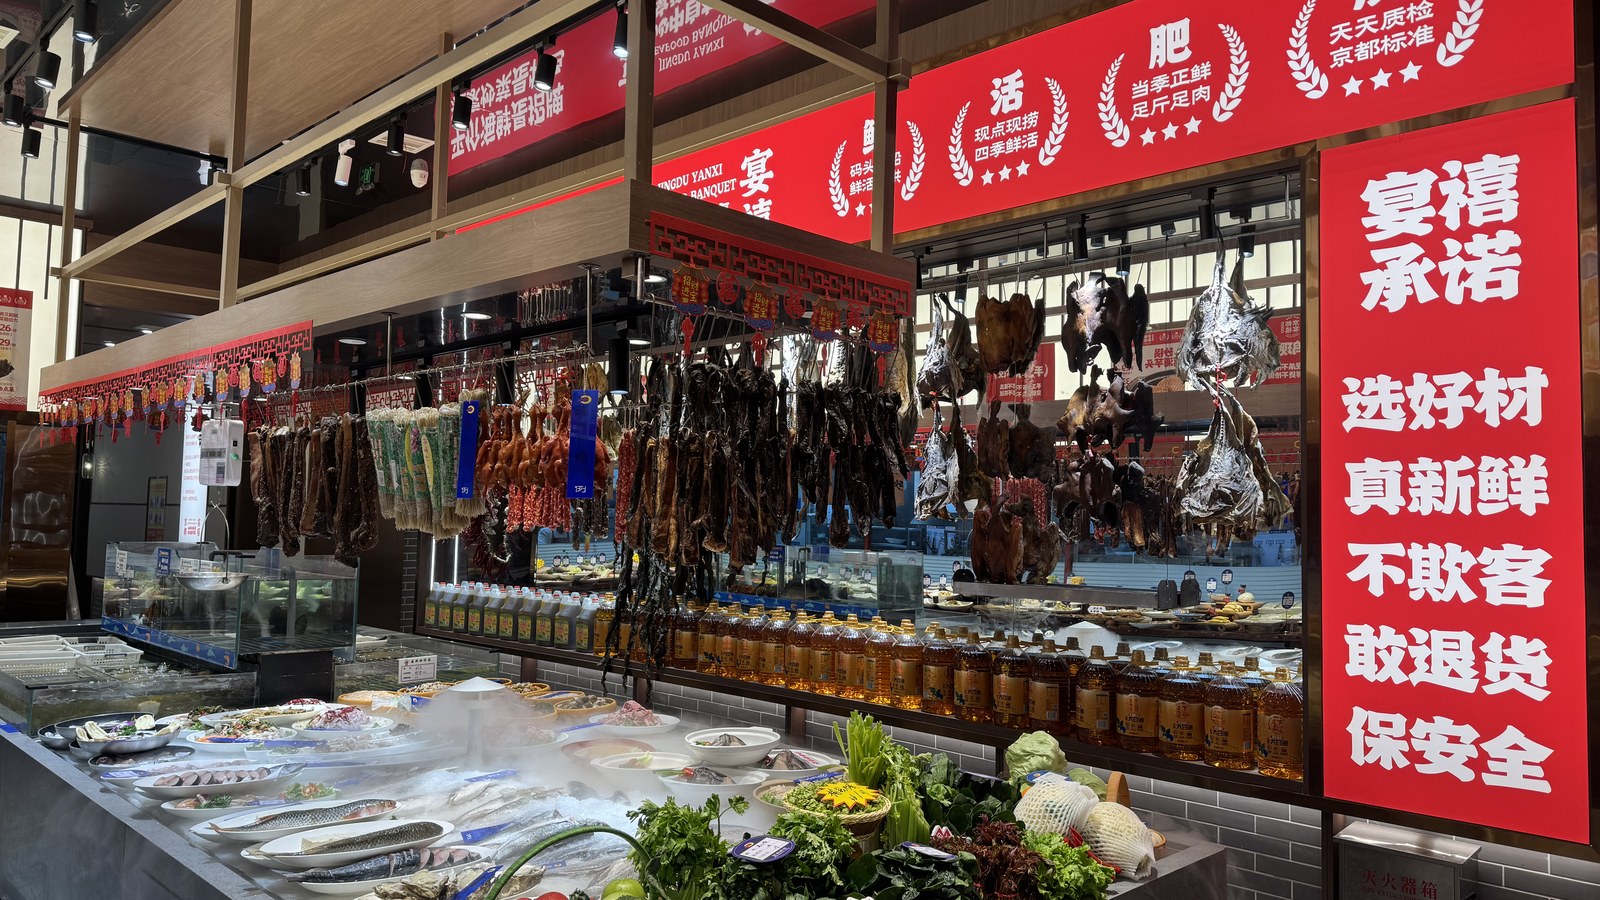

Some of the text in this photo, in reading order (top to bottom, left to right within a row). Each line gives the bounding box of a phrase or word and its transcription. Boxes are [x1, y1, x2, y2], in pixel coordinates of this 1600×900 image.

[1147, 17, 1193, 69] 肥
[1329, 0, 1435, 45] 天天质检
[1329, 24, 1435, 69] 京都标准
[989, 68, 1024, 116] 活
[1130, 84, 1211, 121] 足斤足肉
[1131, 60, 1212, 100] 当季正鲜
[974, 110, 1039, 143] 现点现捞
[974, 131, 1039, 162] 四季鲜活
[690, 178, 737, 200] BANQUET
[691, 163, 723, 183] YANXI
[1360, 154, 1520, 242] 宴禧
[1360, 229, 1522, 313] 承诺
[1341, 365, 1549, 433] 选好材
[1344, 454, 1550, 517] 真新鲜
[1346, 541, 1553, 608] 不欺客
[1344, 623, 1553, 702] 敢退货
[1345, 705, 1555, 795] 保安全
[1362, 869, 1437, 900] 灭火器箱
